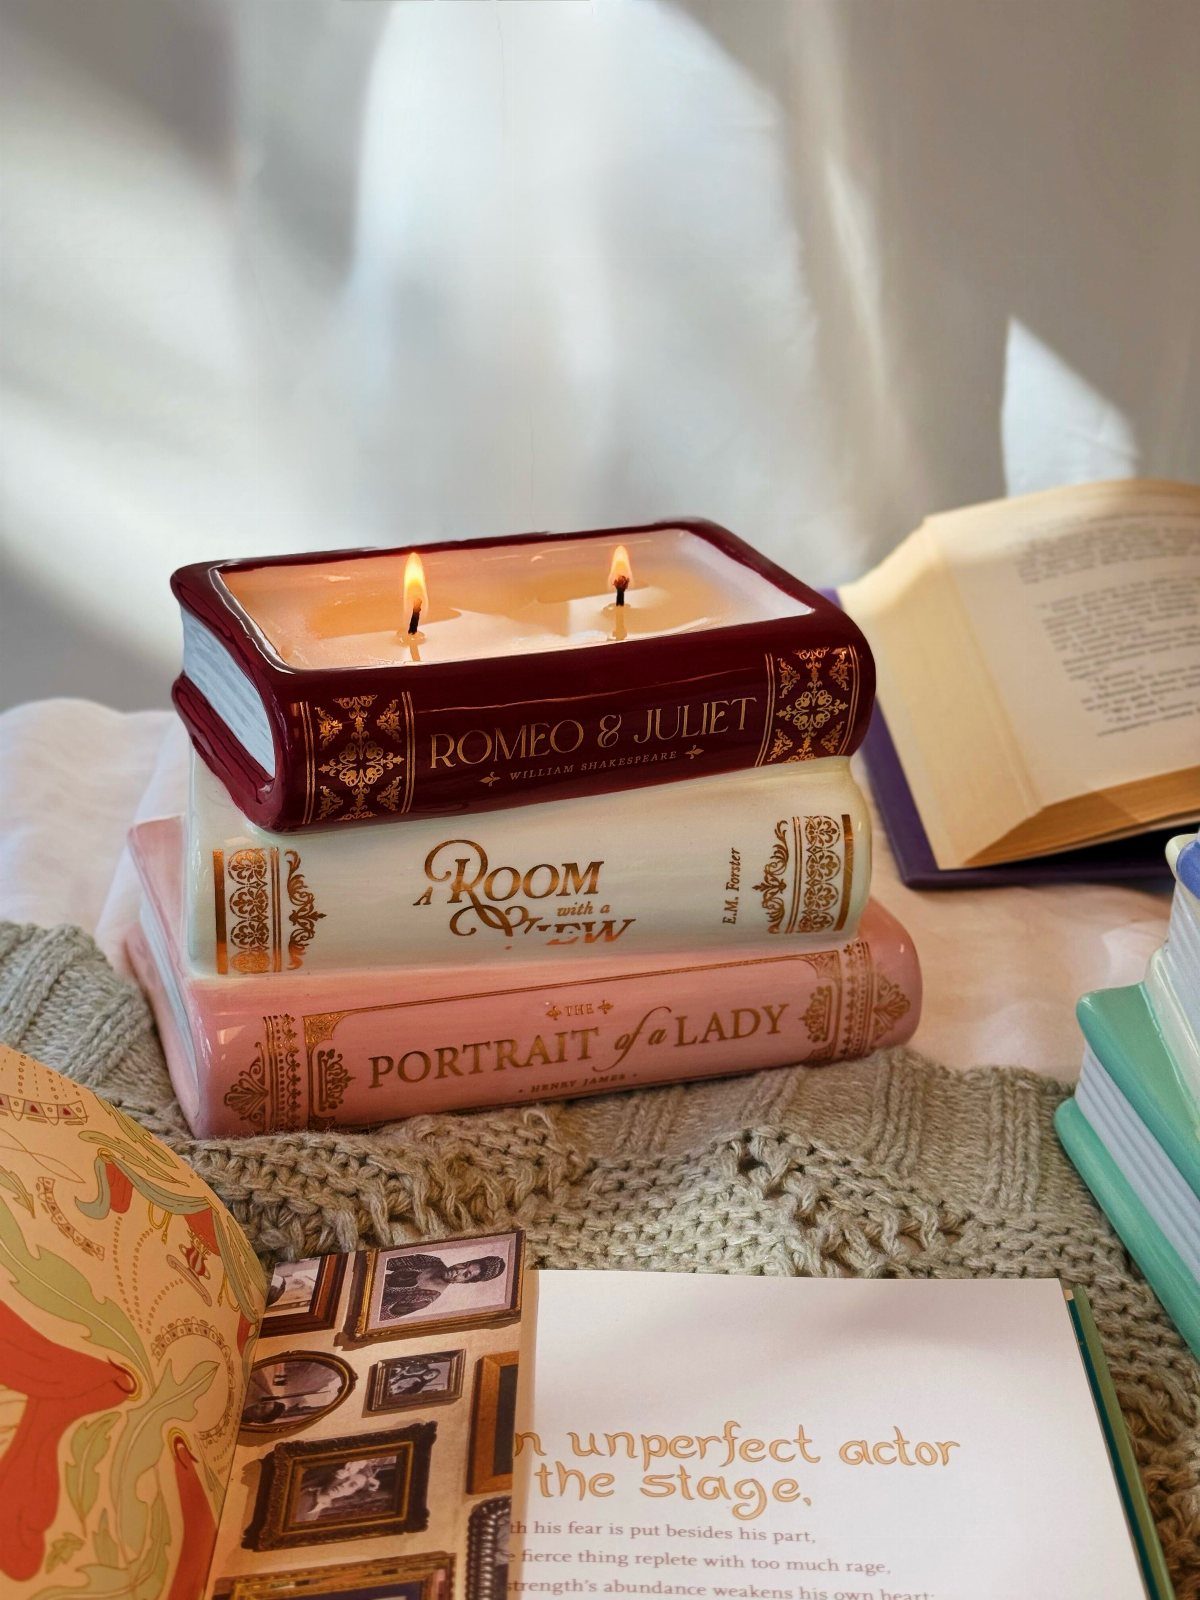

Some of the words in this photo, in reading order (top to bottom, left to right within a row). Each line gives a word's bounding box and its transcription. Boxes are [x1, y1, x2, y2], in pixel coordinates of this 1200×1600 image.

[430, 719, 584, 769] ROMEO
[597, 714, 622, 748] &
[633, 696, 757, 744] JULIET
[509, 764, 574, 781] WILLIAM
[580, 750, 678, 772] SHAKESPEARE
[725, 847, 741, 892] Forster
[412, 886, 432, 906] A
[424, 839, 604, 937] ROOM
[556, 901, 593, 917] with
[600, 904, 611, 914] a
[722, 897, 739, 924] E.M.
[564, 1003, 595, 1017] THE
[368, 1026, 599, 1088] PORTRAIT
[592, 1006, 672, 1073] of
[648, 1026, 667, 1046] a
[673, 1003, 789, 1048] LADY
[530, 1079, 577, 1093] HENRY
[583, 1073, 626, 1086] JAMES
[567, 1420, 821, 1472] unperfect
[838, 1426, 961, 1467] actor
[534, 1460, 615, 1501] the
[639, 1464, 812, 1521] stage,
[534, 1521, 562, 1535] his
[568, 1521, 603, 1536] fear
[609, 1523, 624, 1536] is
[630, 1526, 661, 1540] put
[666, 1524, 733, 1540] besides
[739, 1527, 767, 1541] his
[773, 1530, 816, 1545] part,
[521, 1548, 573, 1563] fierce
[578, 1550, 629, 1568] thing
[635, 1552, 697, 1569] replete
[703, 1554, 745, 1569] with
[751, 1558, 780, 1570] too
[786, 1558, 840, 1572] much
[846, 1563, 891, 1577] rage,
[603, 1579, 707, 1596] abundance
[713, 1585, 793, 1600] weakens
[799, 1587, 828, 1600] his
[833, 1591, 873, 1600] own
